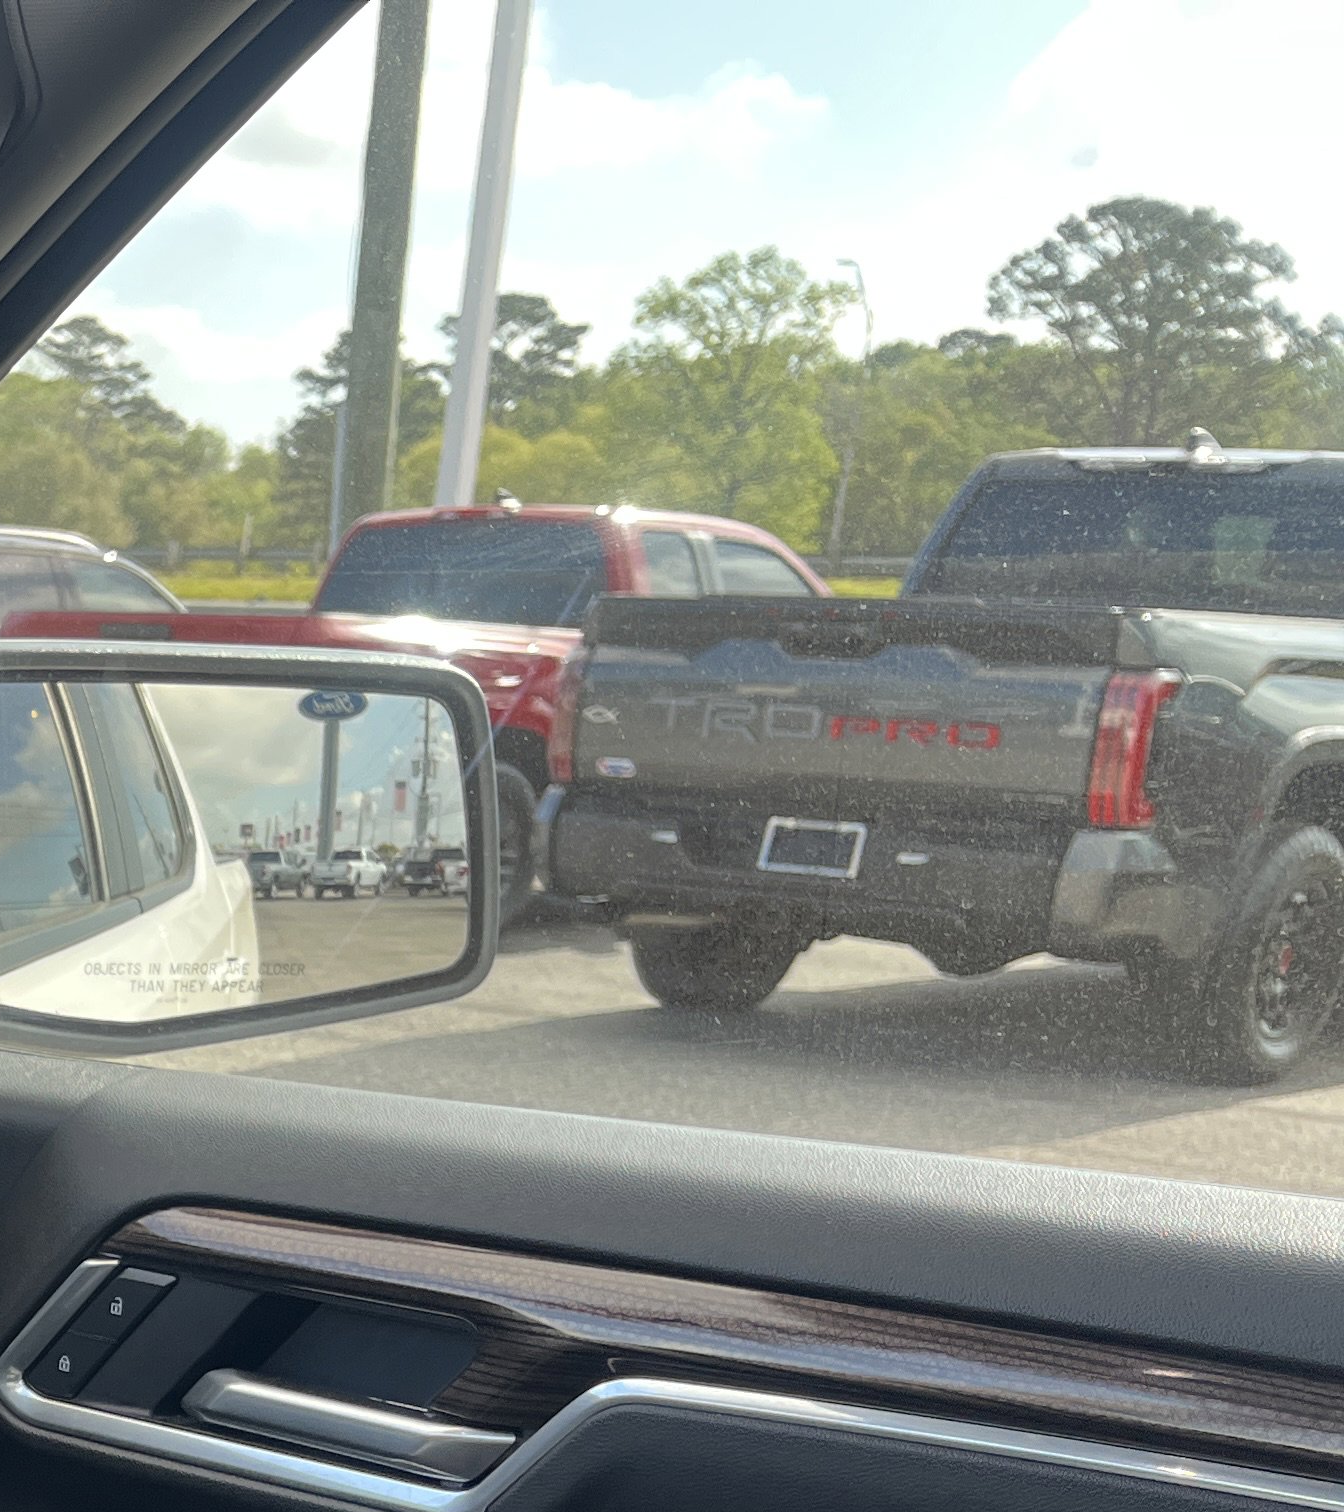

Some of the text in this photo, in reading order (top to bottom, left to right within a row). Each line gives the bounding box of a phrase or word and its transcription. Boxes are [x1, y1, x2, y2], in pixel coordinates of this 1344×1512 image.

[828, 714, 1002, 750] PRO
[83, 962, 305, 976] OBJECTS IN MIRROR ARE CLOSER
[130, 979, 264, 993] THAN THEY APPEAR
